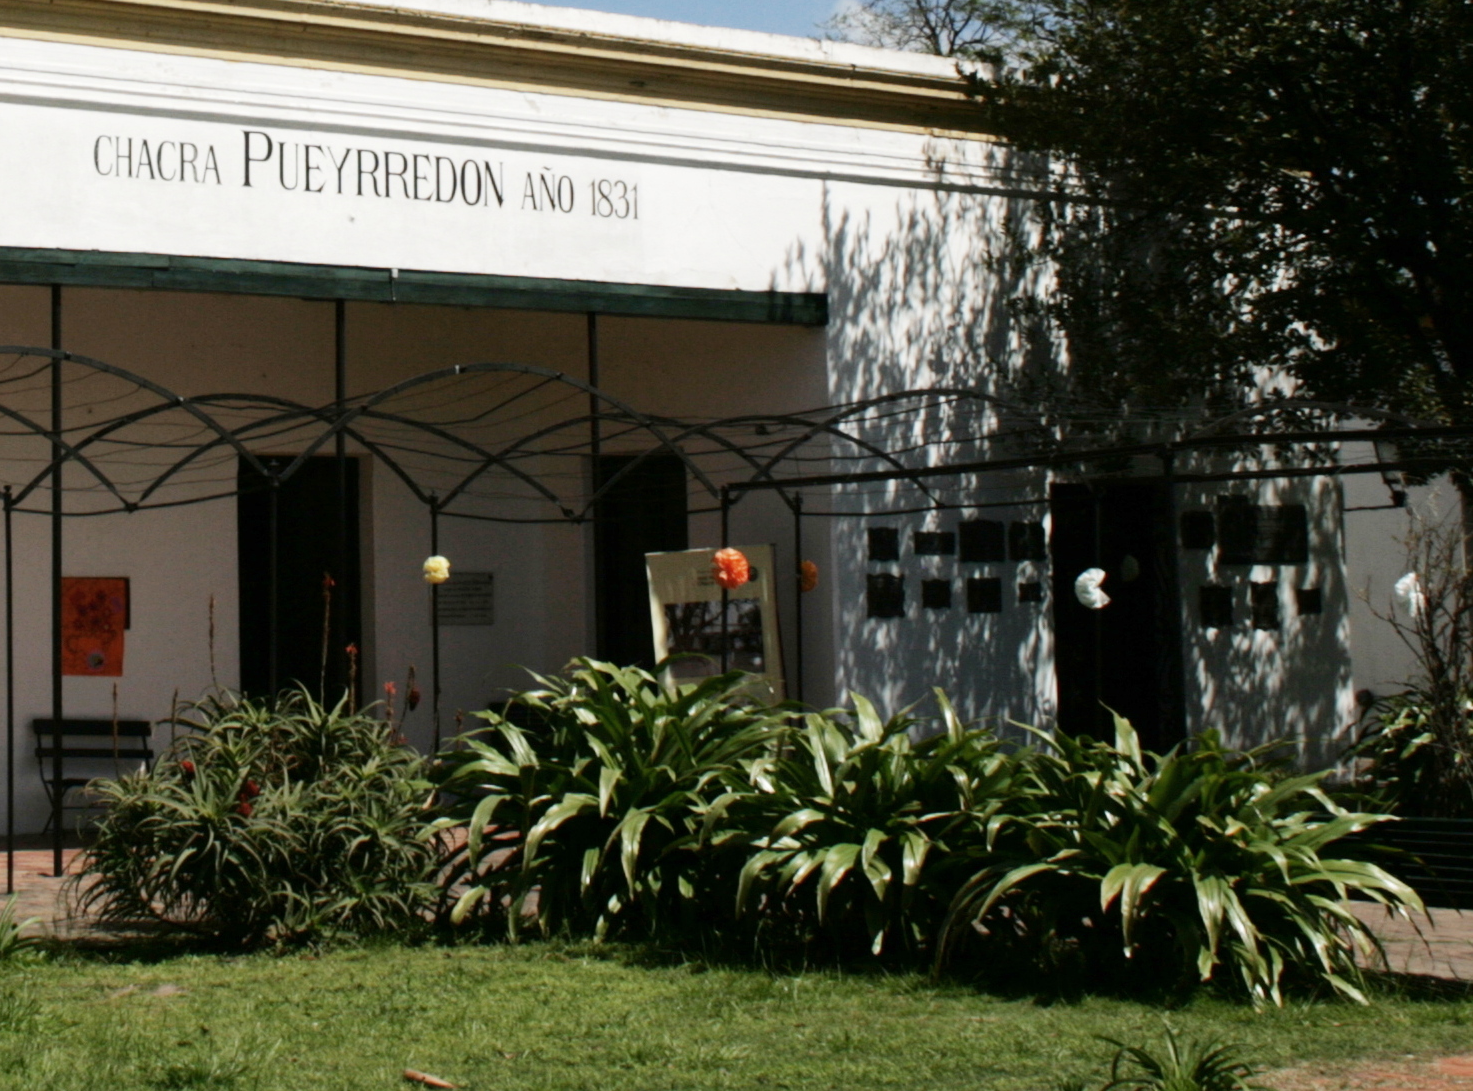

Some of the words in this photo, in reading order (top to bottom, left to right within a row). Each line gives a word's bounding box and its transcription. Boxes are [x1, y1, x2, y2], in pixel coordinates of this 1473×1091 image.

[93, 134, 223, 186] CHACRA
[241, 130, 505, 209] PUEYRREDON
[521, 166, 576, 214] AÑO
[588, 179, 640, 221] 1831
